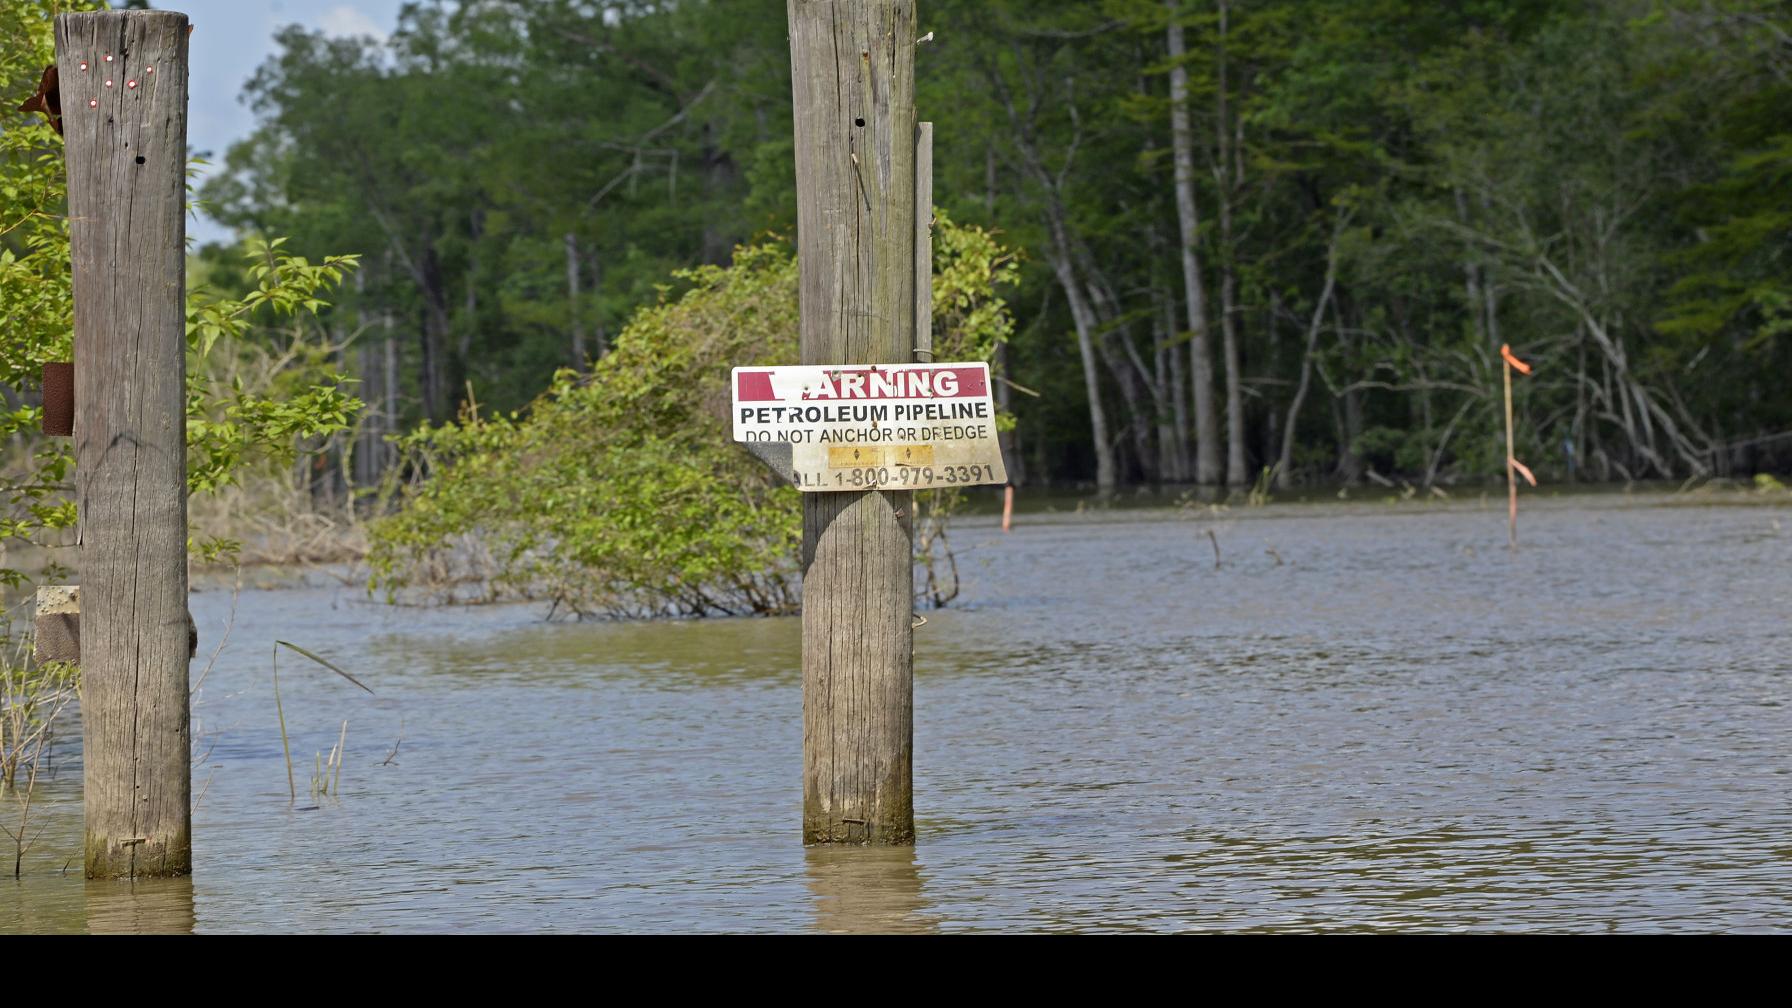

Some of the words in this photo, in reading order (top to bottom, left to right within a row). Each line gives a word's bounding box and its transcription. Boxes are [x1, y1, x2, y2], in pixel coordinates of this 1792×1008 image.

[768, 370, 959, 398] ARNING
[740, 406, 888, 424] PETROLEUM
[895, 402, 988, 420] PIPELINE
[746, 430, 771, 443] DO
[778, 429, 814, 444] NOT
[820, 427, 893, 443] ANCHOR
[897, 427, 916, 441] OR
[921, 425, 988, 441] DREDGE
[793, 472, 828, 486] ALL
[836, 464, 994, 487] 1-800-979-3391
